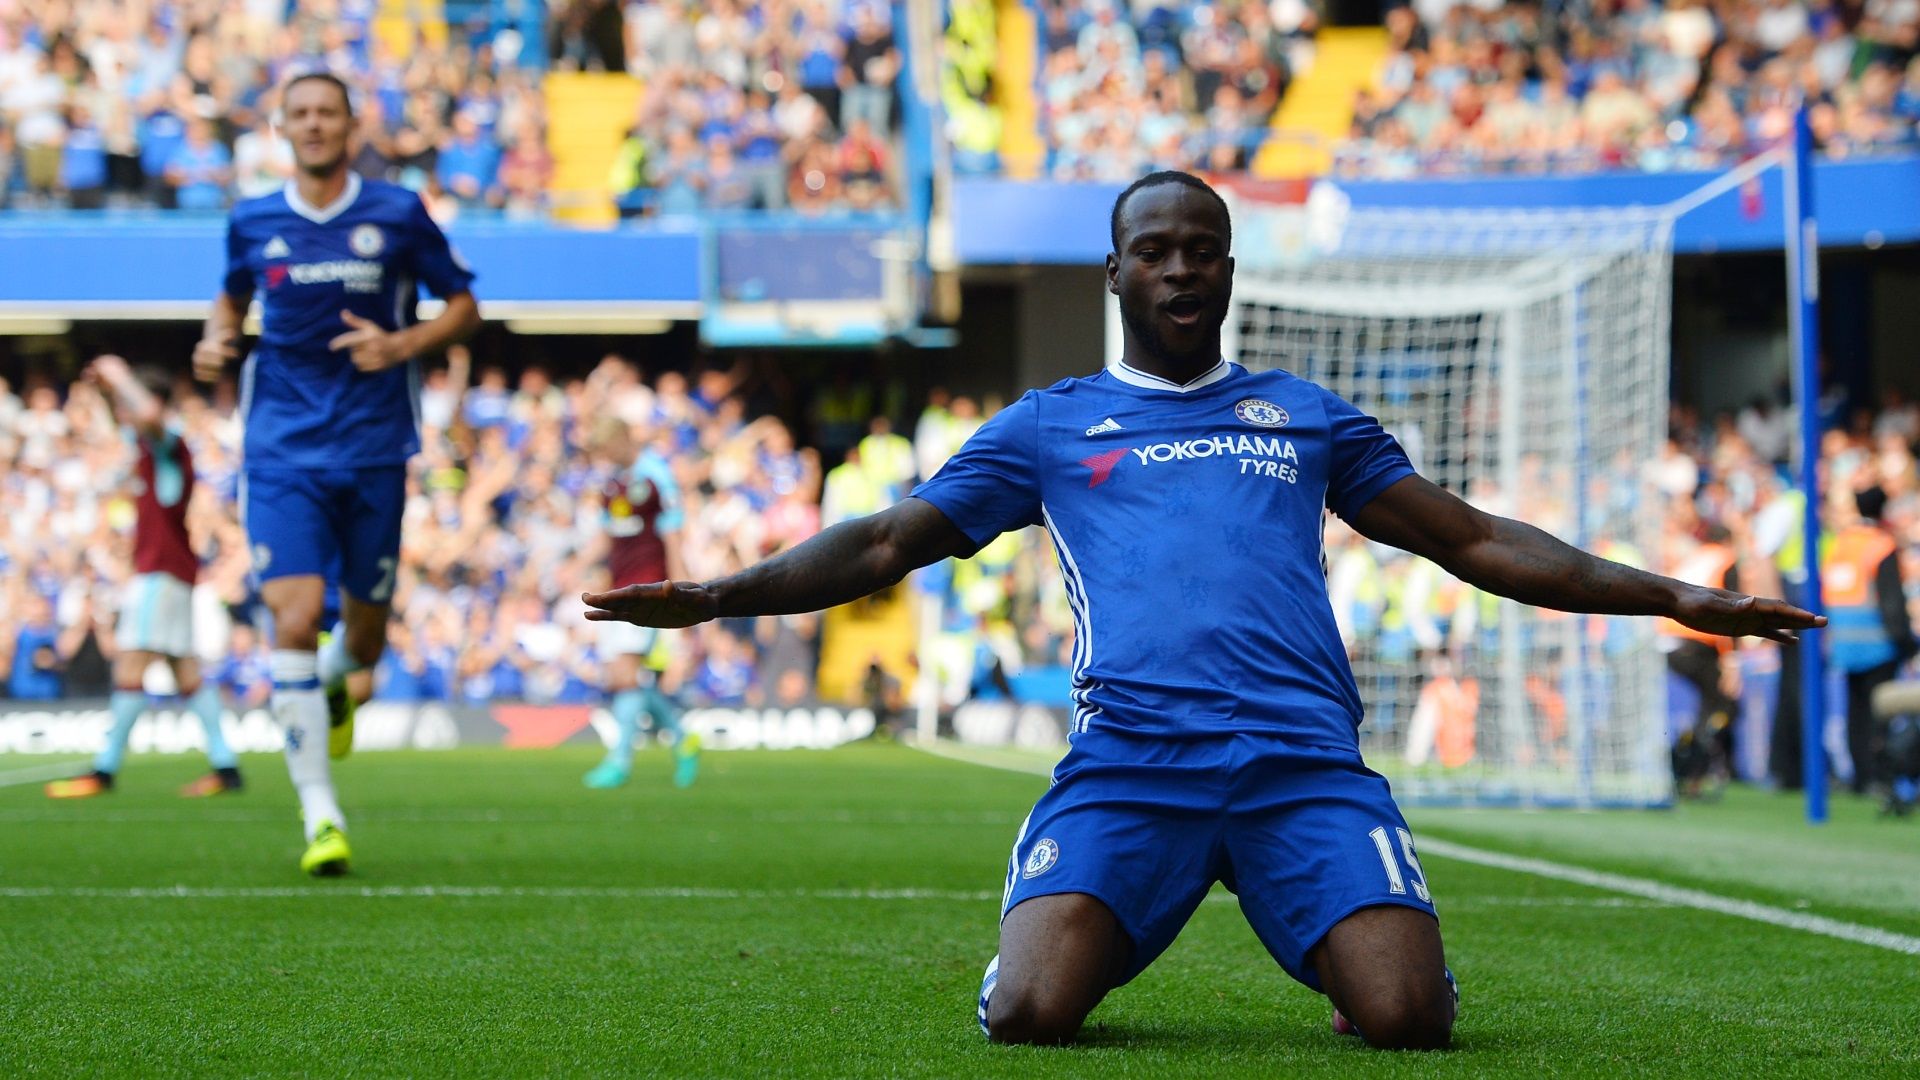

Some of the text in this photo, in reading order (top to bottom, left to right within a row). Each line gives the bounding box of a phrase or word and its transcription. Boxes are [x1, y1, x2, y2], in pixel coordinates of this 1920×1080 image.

[1132, 434, 1299, 466] YOKOHAMA
[1239, 457, 1298, 485] TYRES
[1369, 826, 1431, 903] 15
